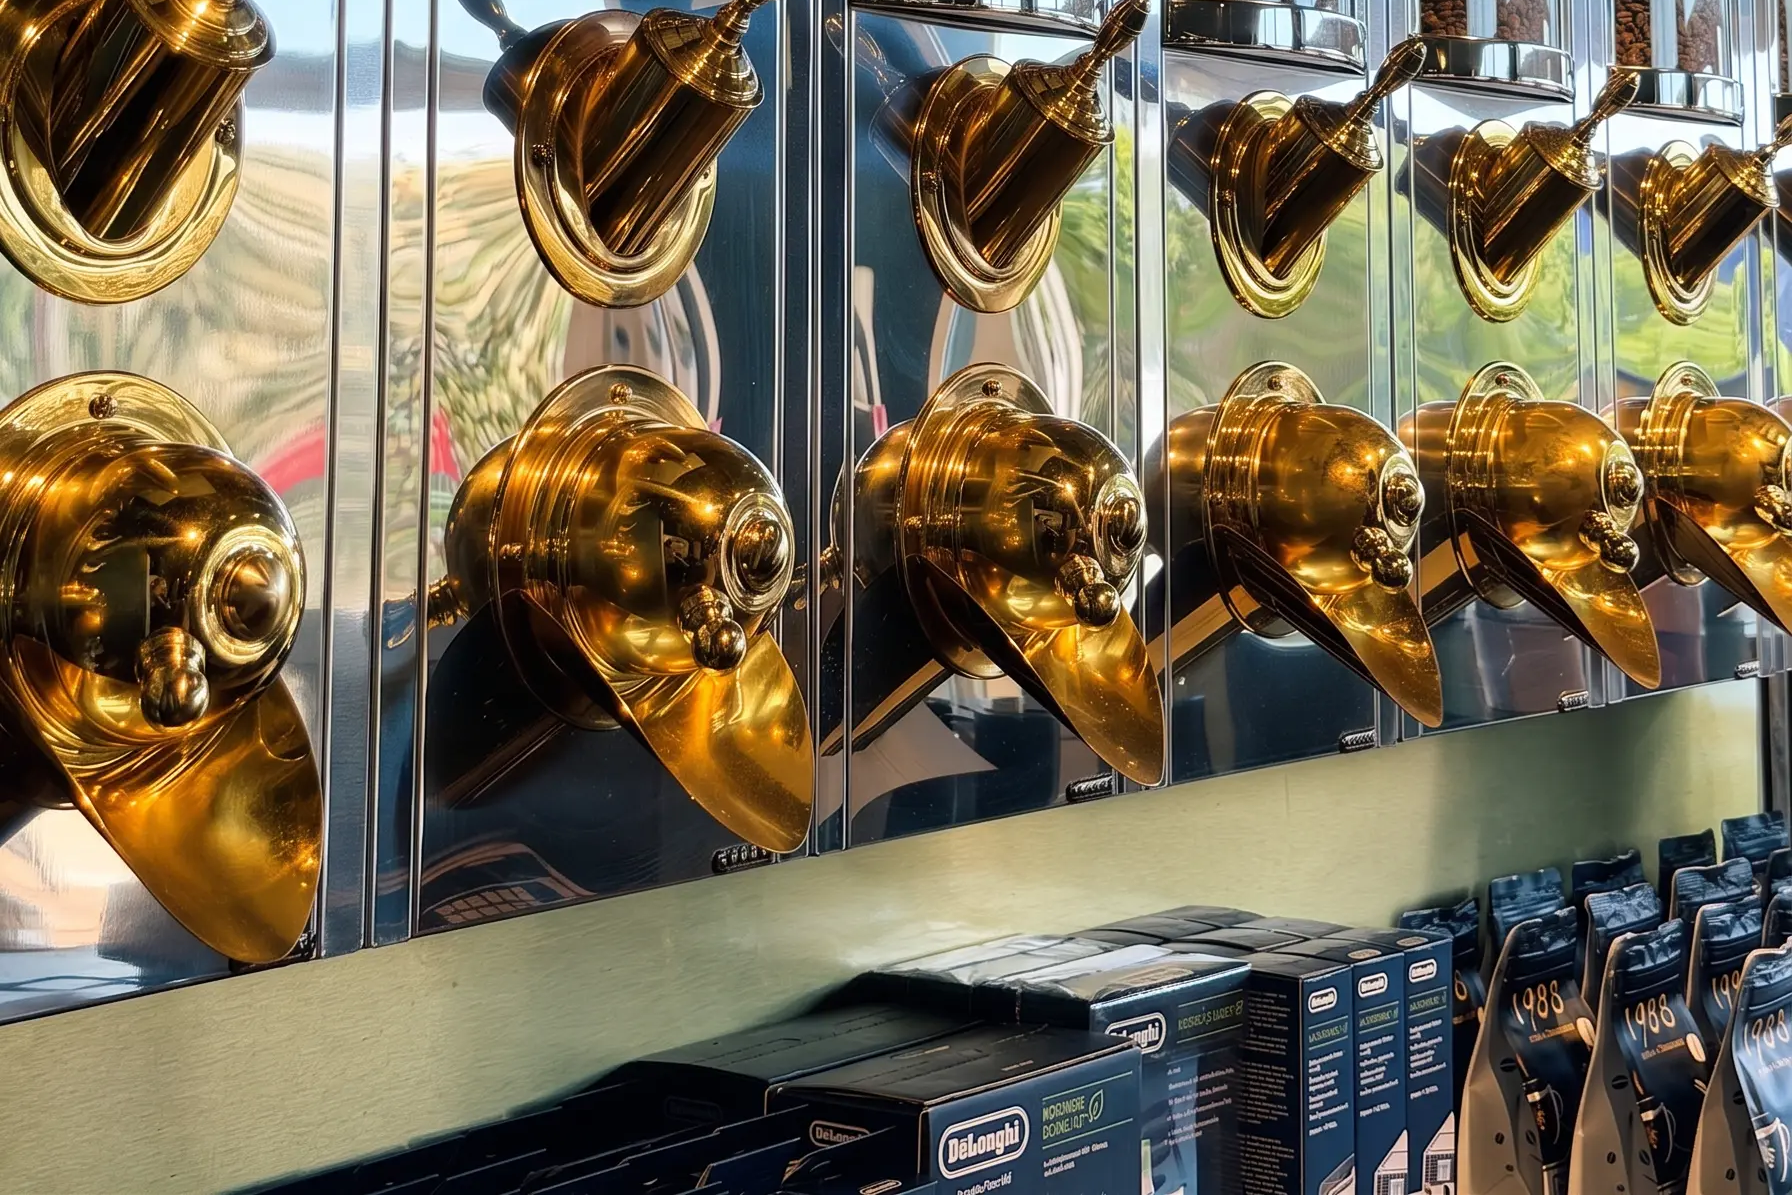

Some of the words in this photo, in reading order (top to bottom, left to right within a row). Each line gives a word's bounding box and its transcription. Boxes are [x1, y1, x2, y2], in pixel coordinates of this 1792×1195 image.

[1513, 980, 1564, 1032] 1988
[1625, 994, 1676, 1048] 1988
[1744, 1009, 1790, 1068] 1988
